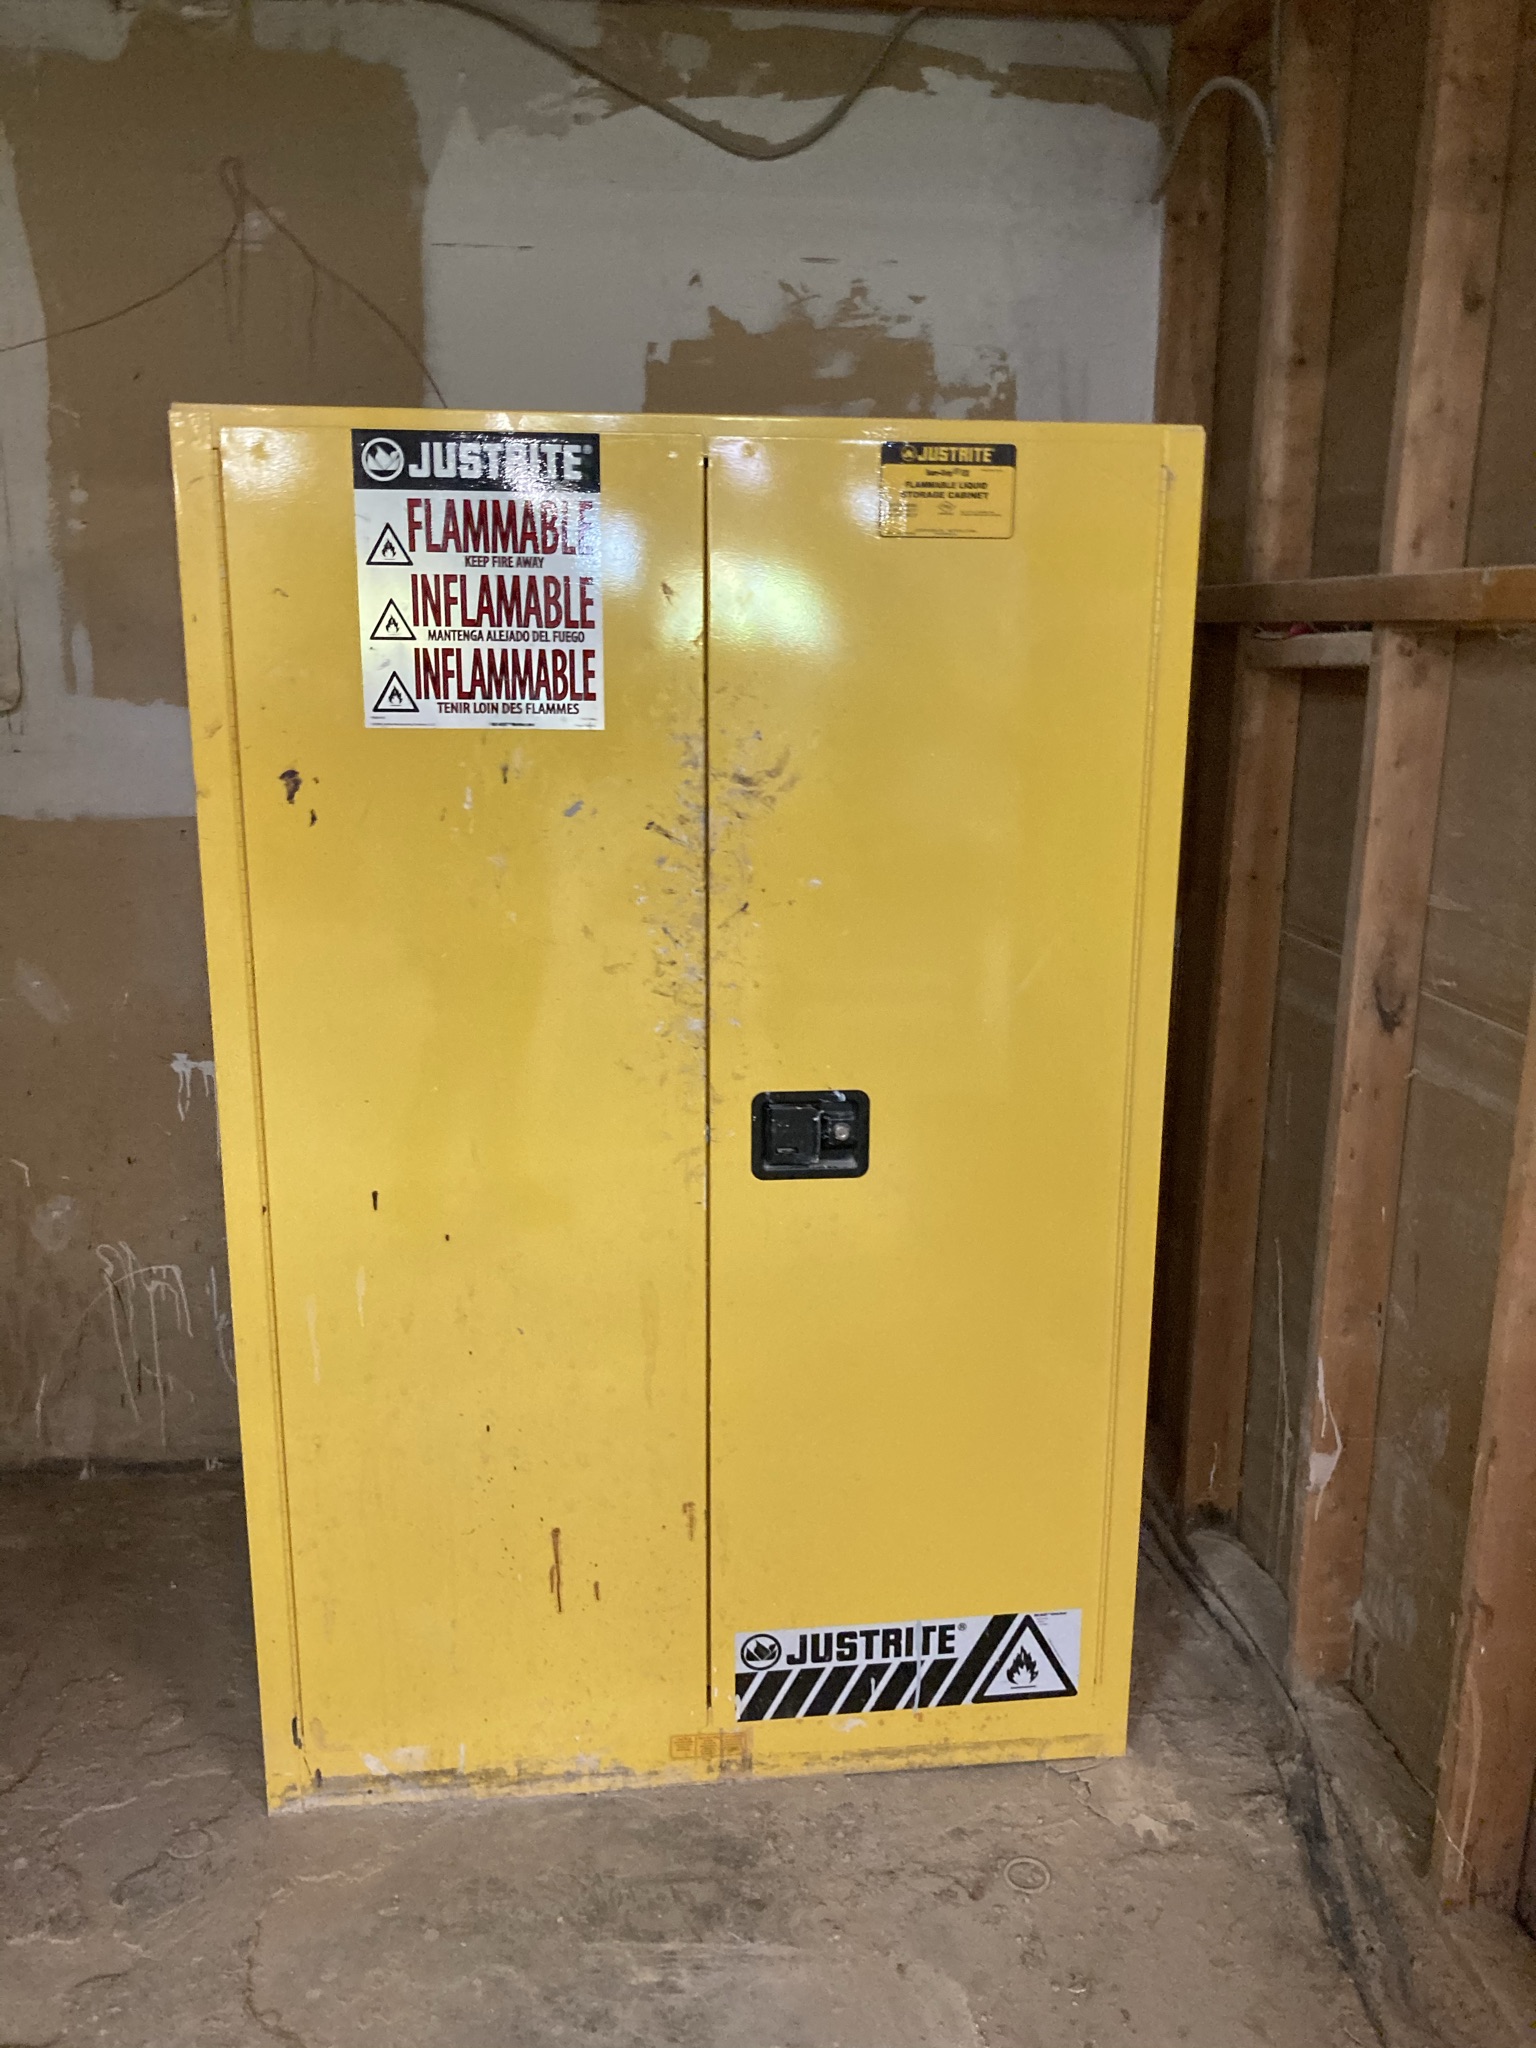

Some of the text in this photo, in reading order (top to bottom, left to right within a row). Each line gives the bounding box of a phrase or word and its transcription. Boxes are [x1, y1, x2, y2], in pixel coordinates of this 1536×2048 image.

[917, 446, 993, 463] JUSTRITE
[905, 481, 988, 490] FLAMMABLE LIQUID
[900, 491, 989, 500] STORAGE CABINET
[406, 497, 593, 556] FLAMMABLE
[464, 556, 544, 569] KEEP FIRE AWAY
[410, 573, 596, 629] INFLAMABLE
[427, 629, 585, 643] MANTENGA ALEJADO DEL FUEGO
[413, 647, 597, 702] INFLAMMABLE
[436, 702, 580, 716] TENIR LOIN DES FLAMMES
